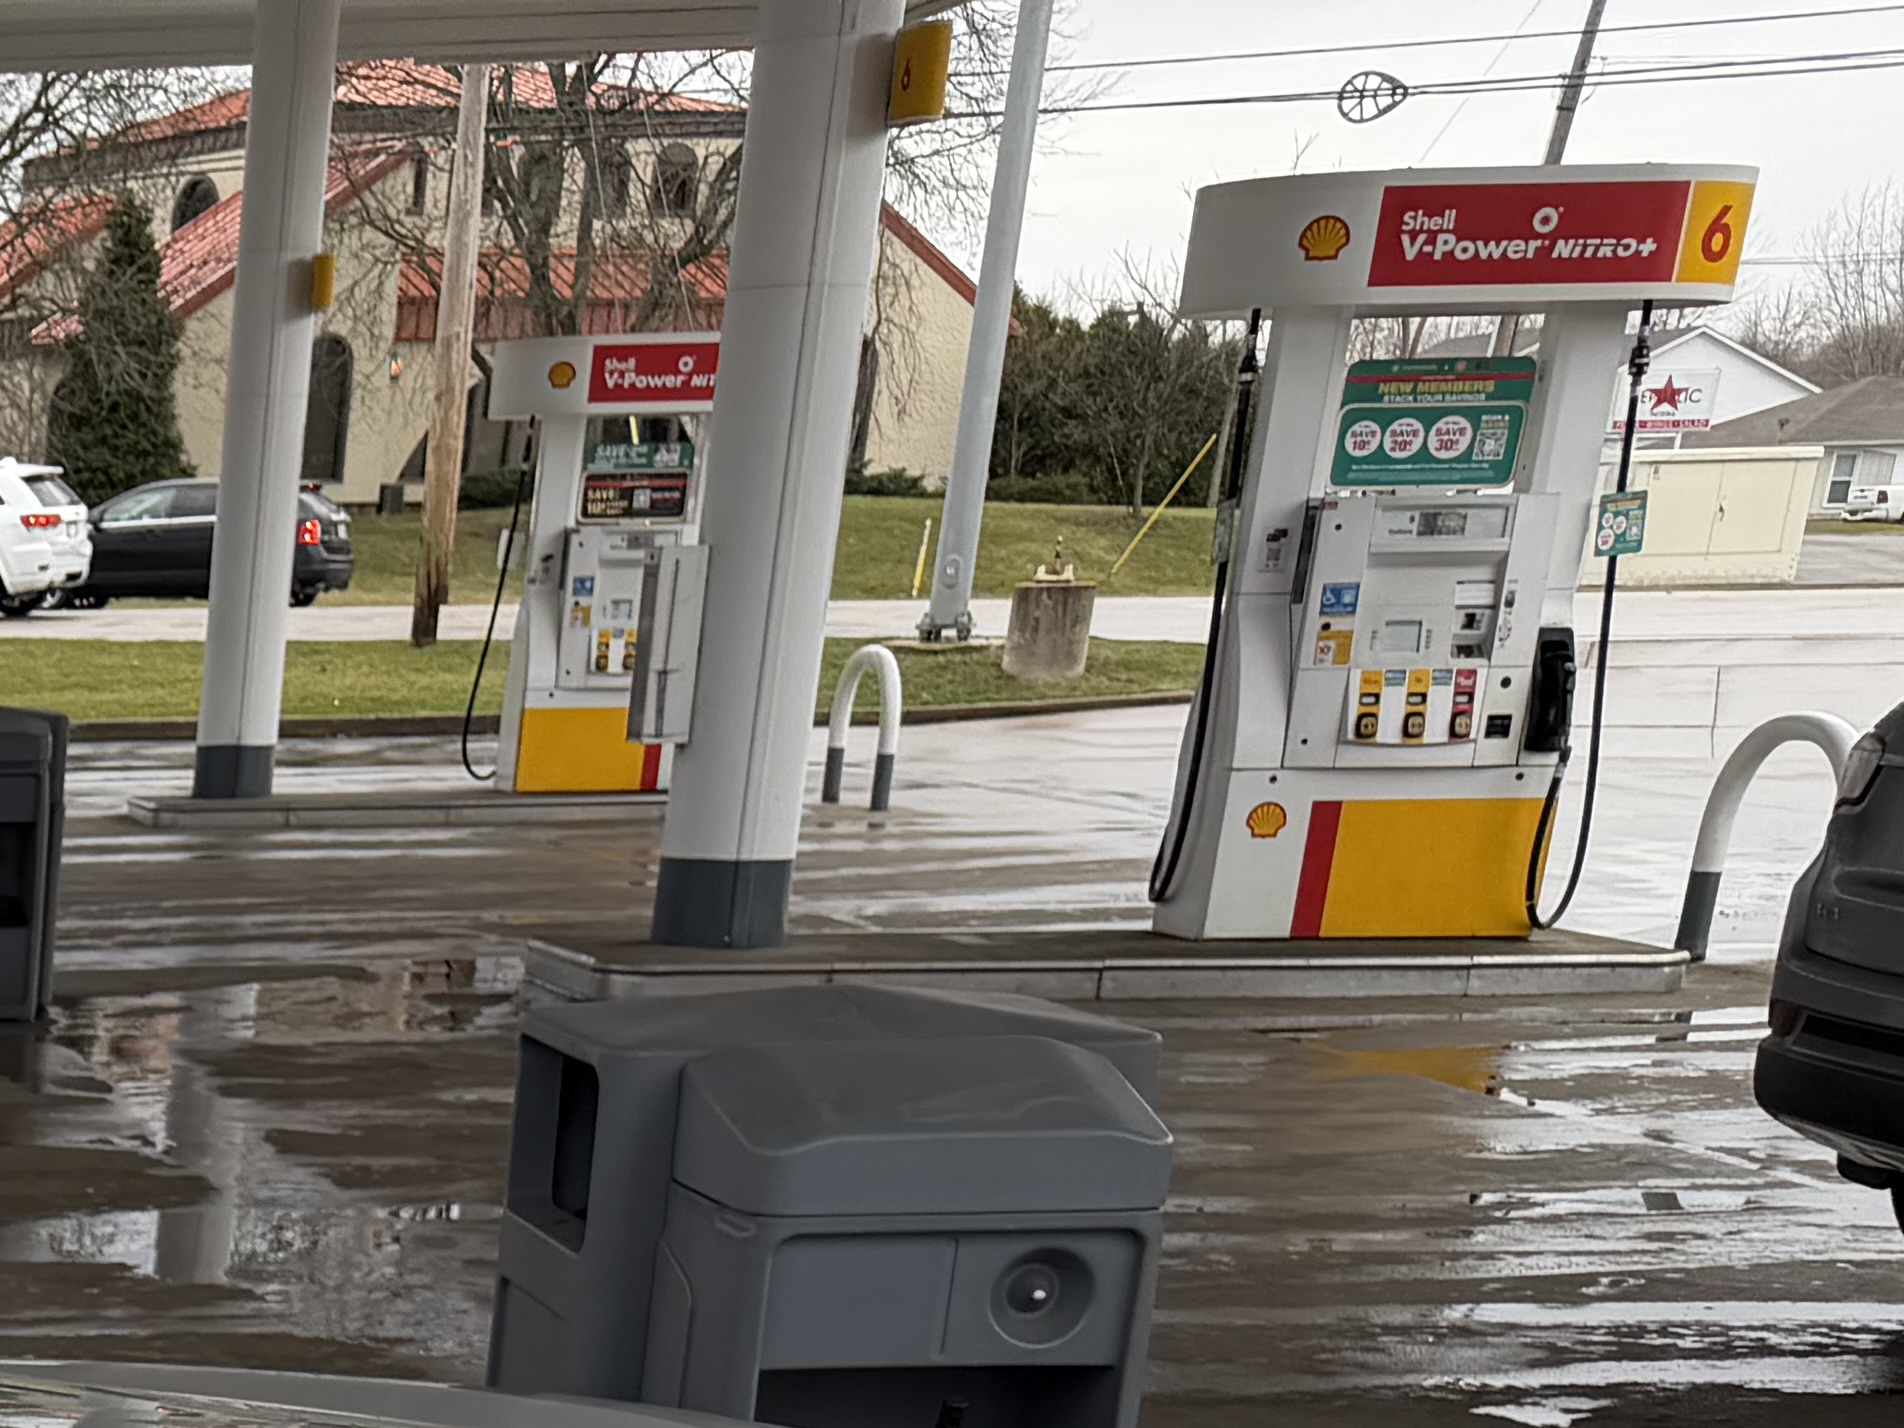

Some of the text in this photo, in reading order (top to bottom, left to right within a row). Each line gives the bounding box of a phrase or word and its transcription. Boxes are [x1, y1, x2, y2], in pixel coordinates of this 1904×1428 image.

[1402, 208, 1456, 231] Shell
[1701, 204, 1733, 263] 6
[1400, 233, 1543, 261] V-Power
[604, 372, 686, 389] V-Power
